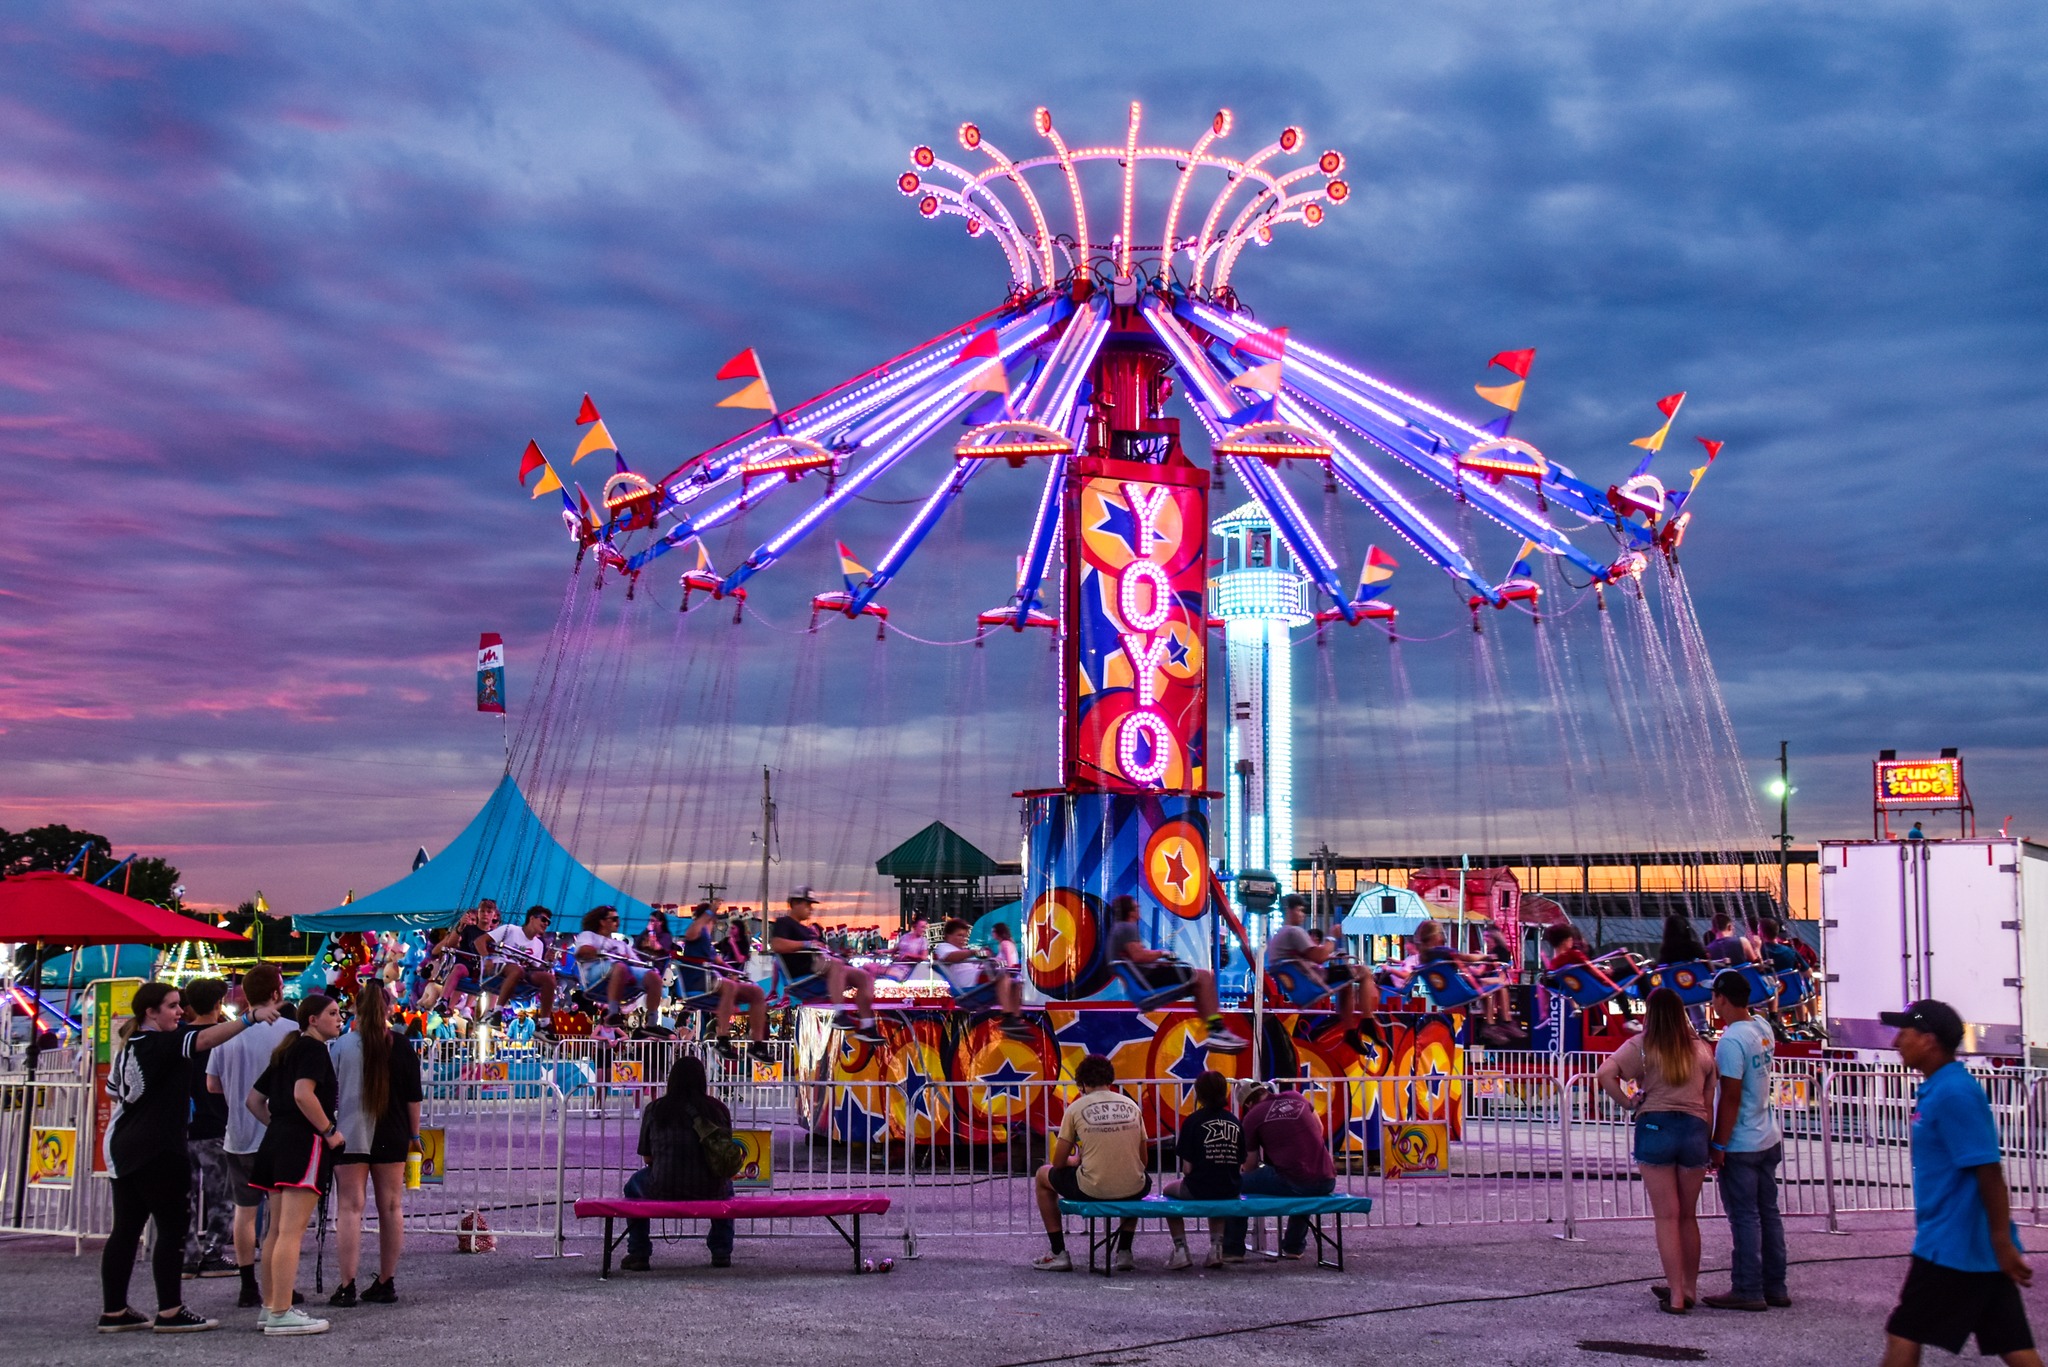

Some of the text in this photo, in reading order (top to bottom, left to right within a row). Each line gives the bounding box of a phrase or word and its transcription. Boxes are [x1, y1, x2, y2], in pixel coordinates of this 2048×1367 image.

[1119, 483, 1170, 786] YOYO
[1895, 767, 1937, 780] FUN
[1889, 781, 1944, 795] SLIDE
[99, 1002, 109, 1042] YES
[1548, 993, 1560, 1053] Quincy
[1112, 1104, 1134, 1114] JON
